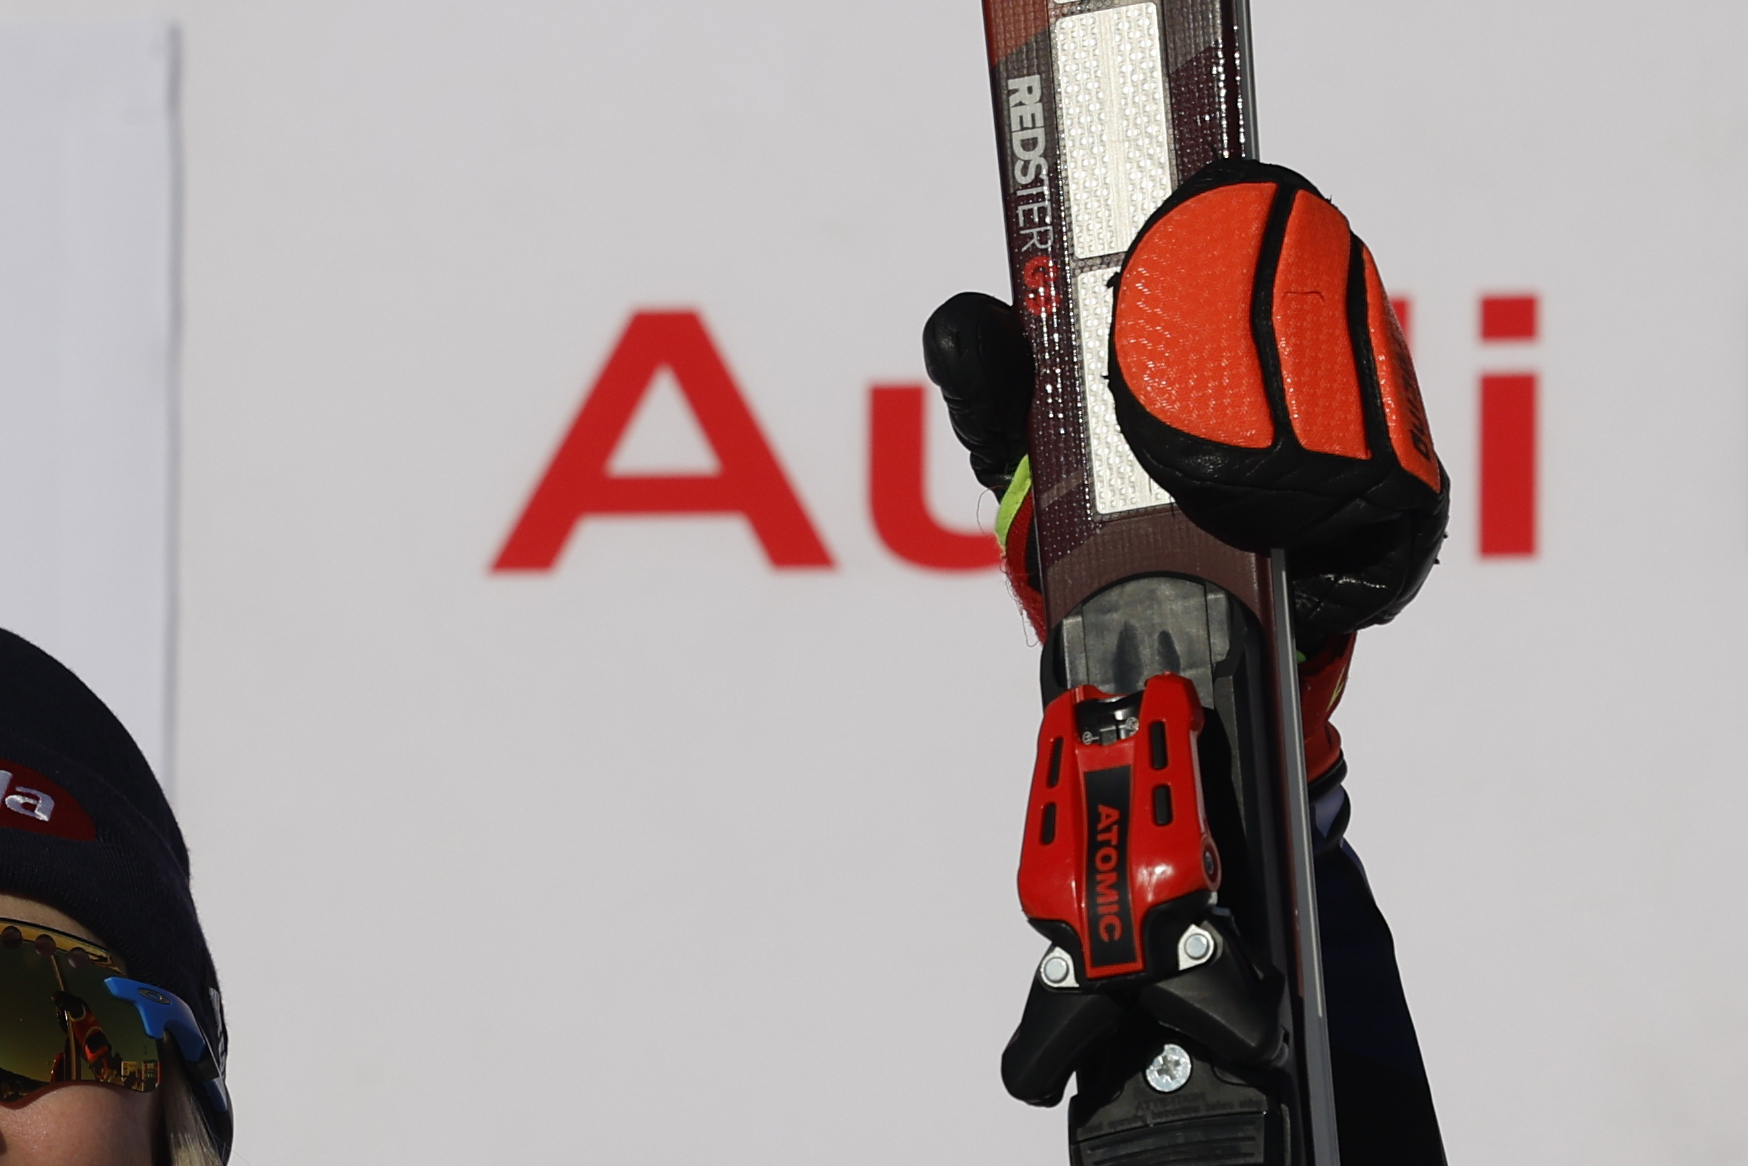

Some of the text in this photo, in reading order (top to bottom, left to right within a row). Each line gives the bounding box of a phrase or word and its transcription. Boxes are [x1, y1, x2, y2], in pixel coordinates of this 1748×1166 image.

[1007, 74, 1054, 253] REDSTER
[493, 296, 1540, 573] Aui
[1095, 804, 1123, 943] ATOMIC
